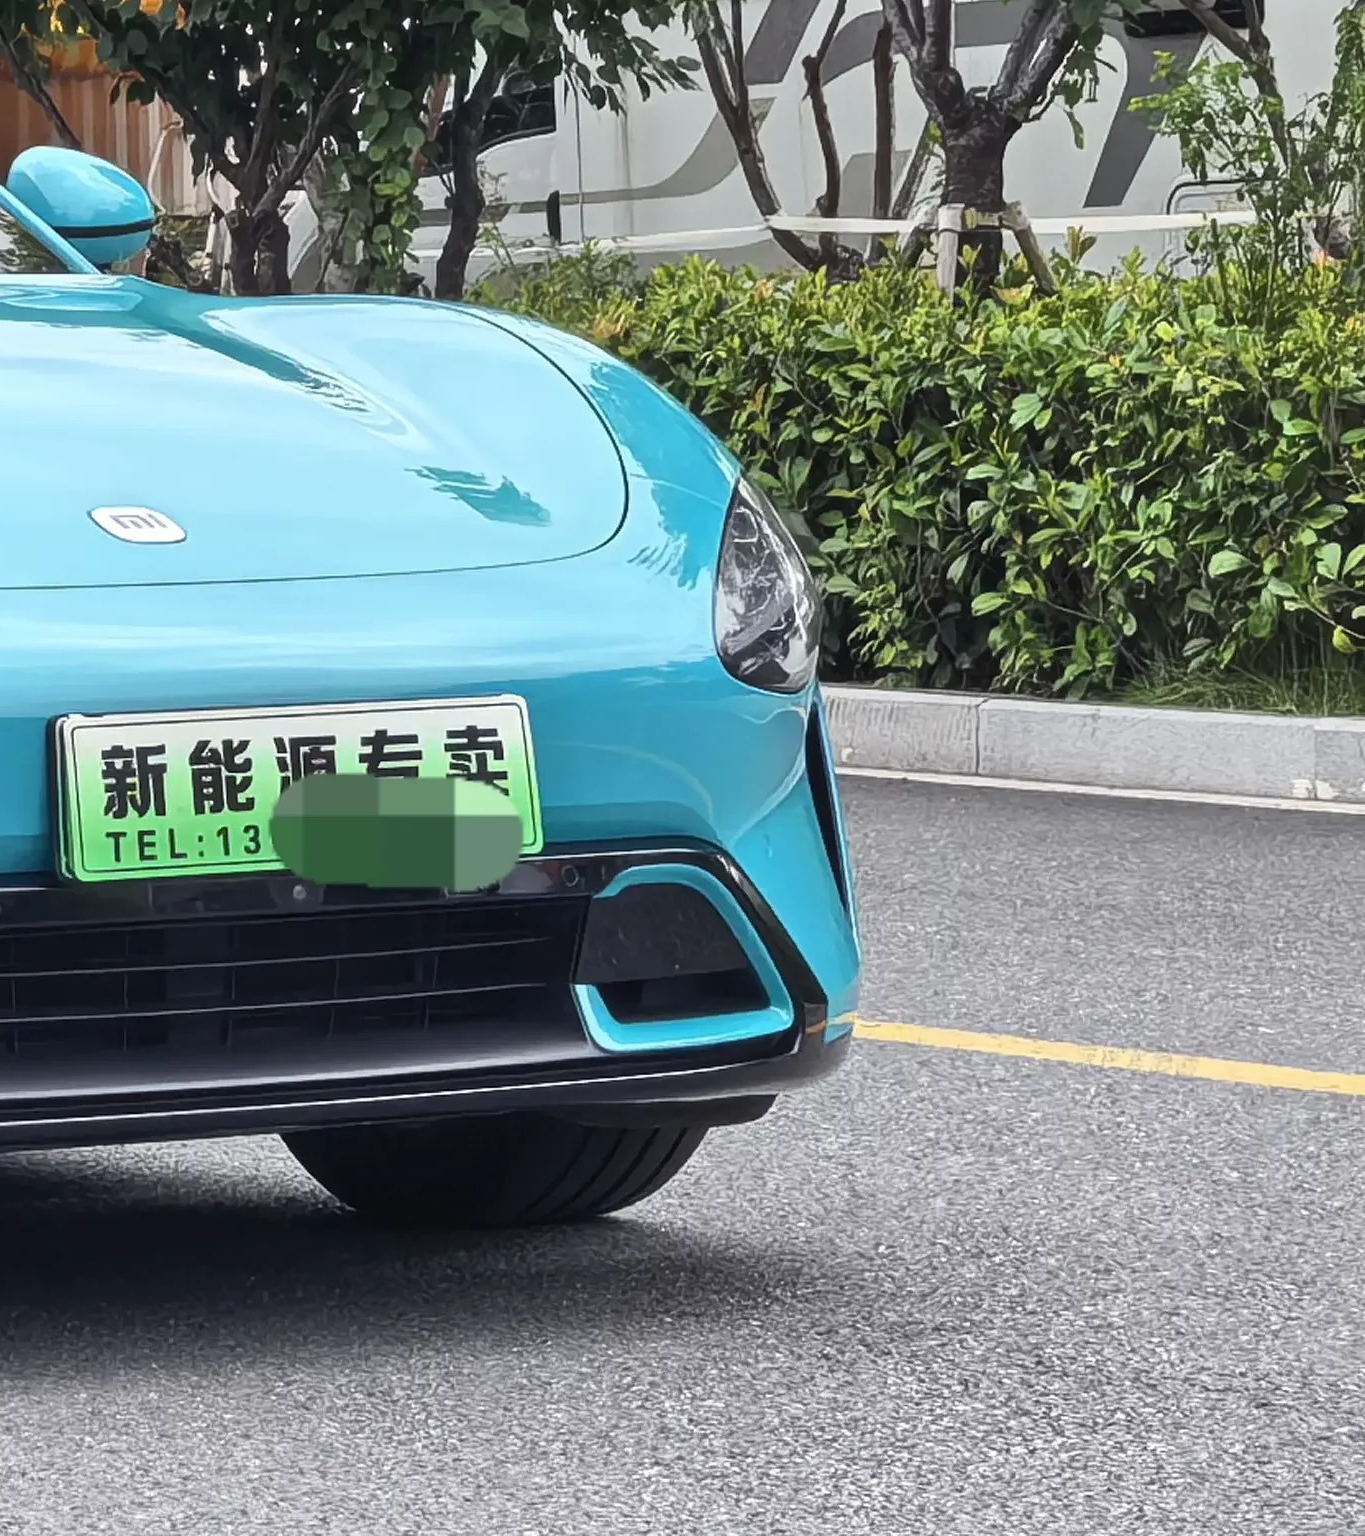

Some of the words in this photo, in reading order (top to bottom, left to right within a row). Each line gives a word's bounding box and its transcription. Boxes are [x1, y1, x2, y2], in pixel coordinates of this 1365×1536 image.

[101, 724, 511, 821] 新能源专卖
[105, 824, 265, 864] TEL:13
